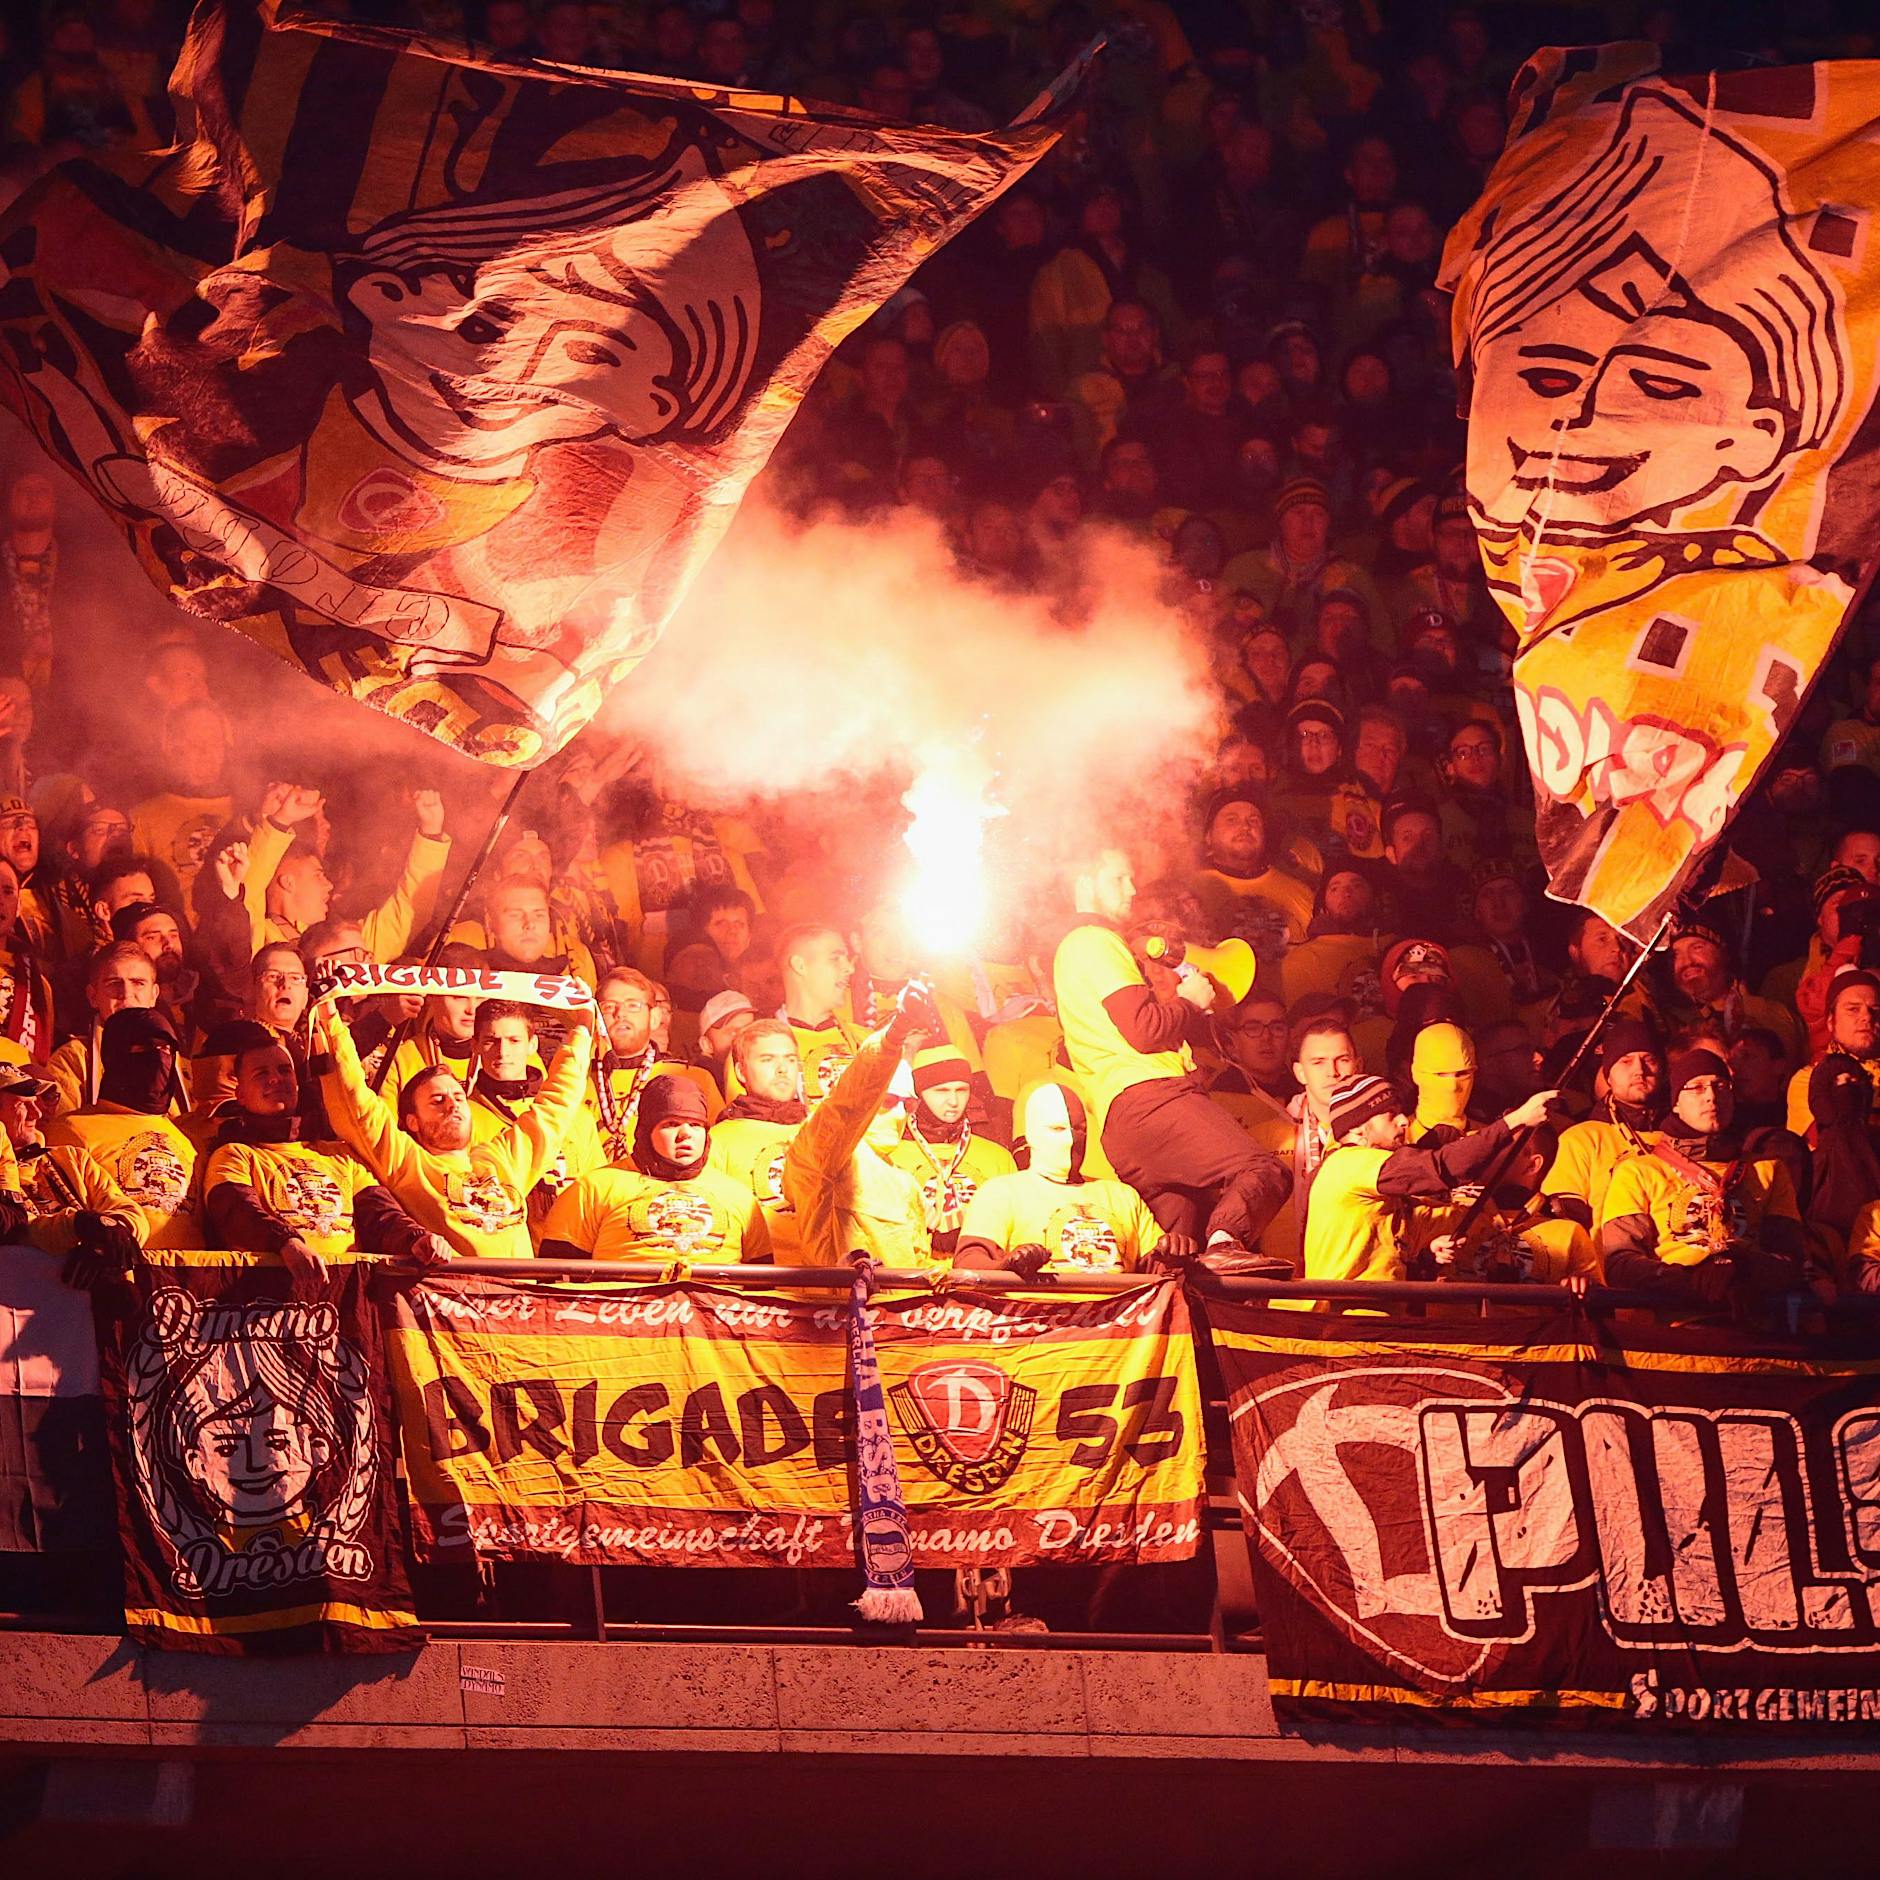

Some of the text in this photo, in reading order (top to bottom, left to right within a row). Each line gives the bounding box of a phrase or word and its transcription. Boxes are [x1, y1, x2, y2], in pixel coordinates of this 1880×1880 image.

[141, 1288, 338, 1358] Dynamo
[555, 1290, 693, 1325] Leben
[713, 1300, 793, 1330] nur
[423, 1375, 1184, 1471] BRIGADE 53
[859, 1408, 898, 1504] BSC
[174, 1523, 372, 1596] Dresden
[436, 1503, 824, 1565] Sportgemeinschaft
[1034, 1509, 1200, 1552] Dresden
